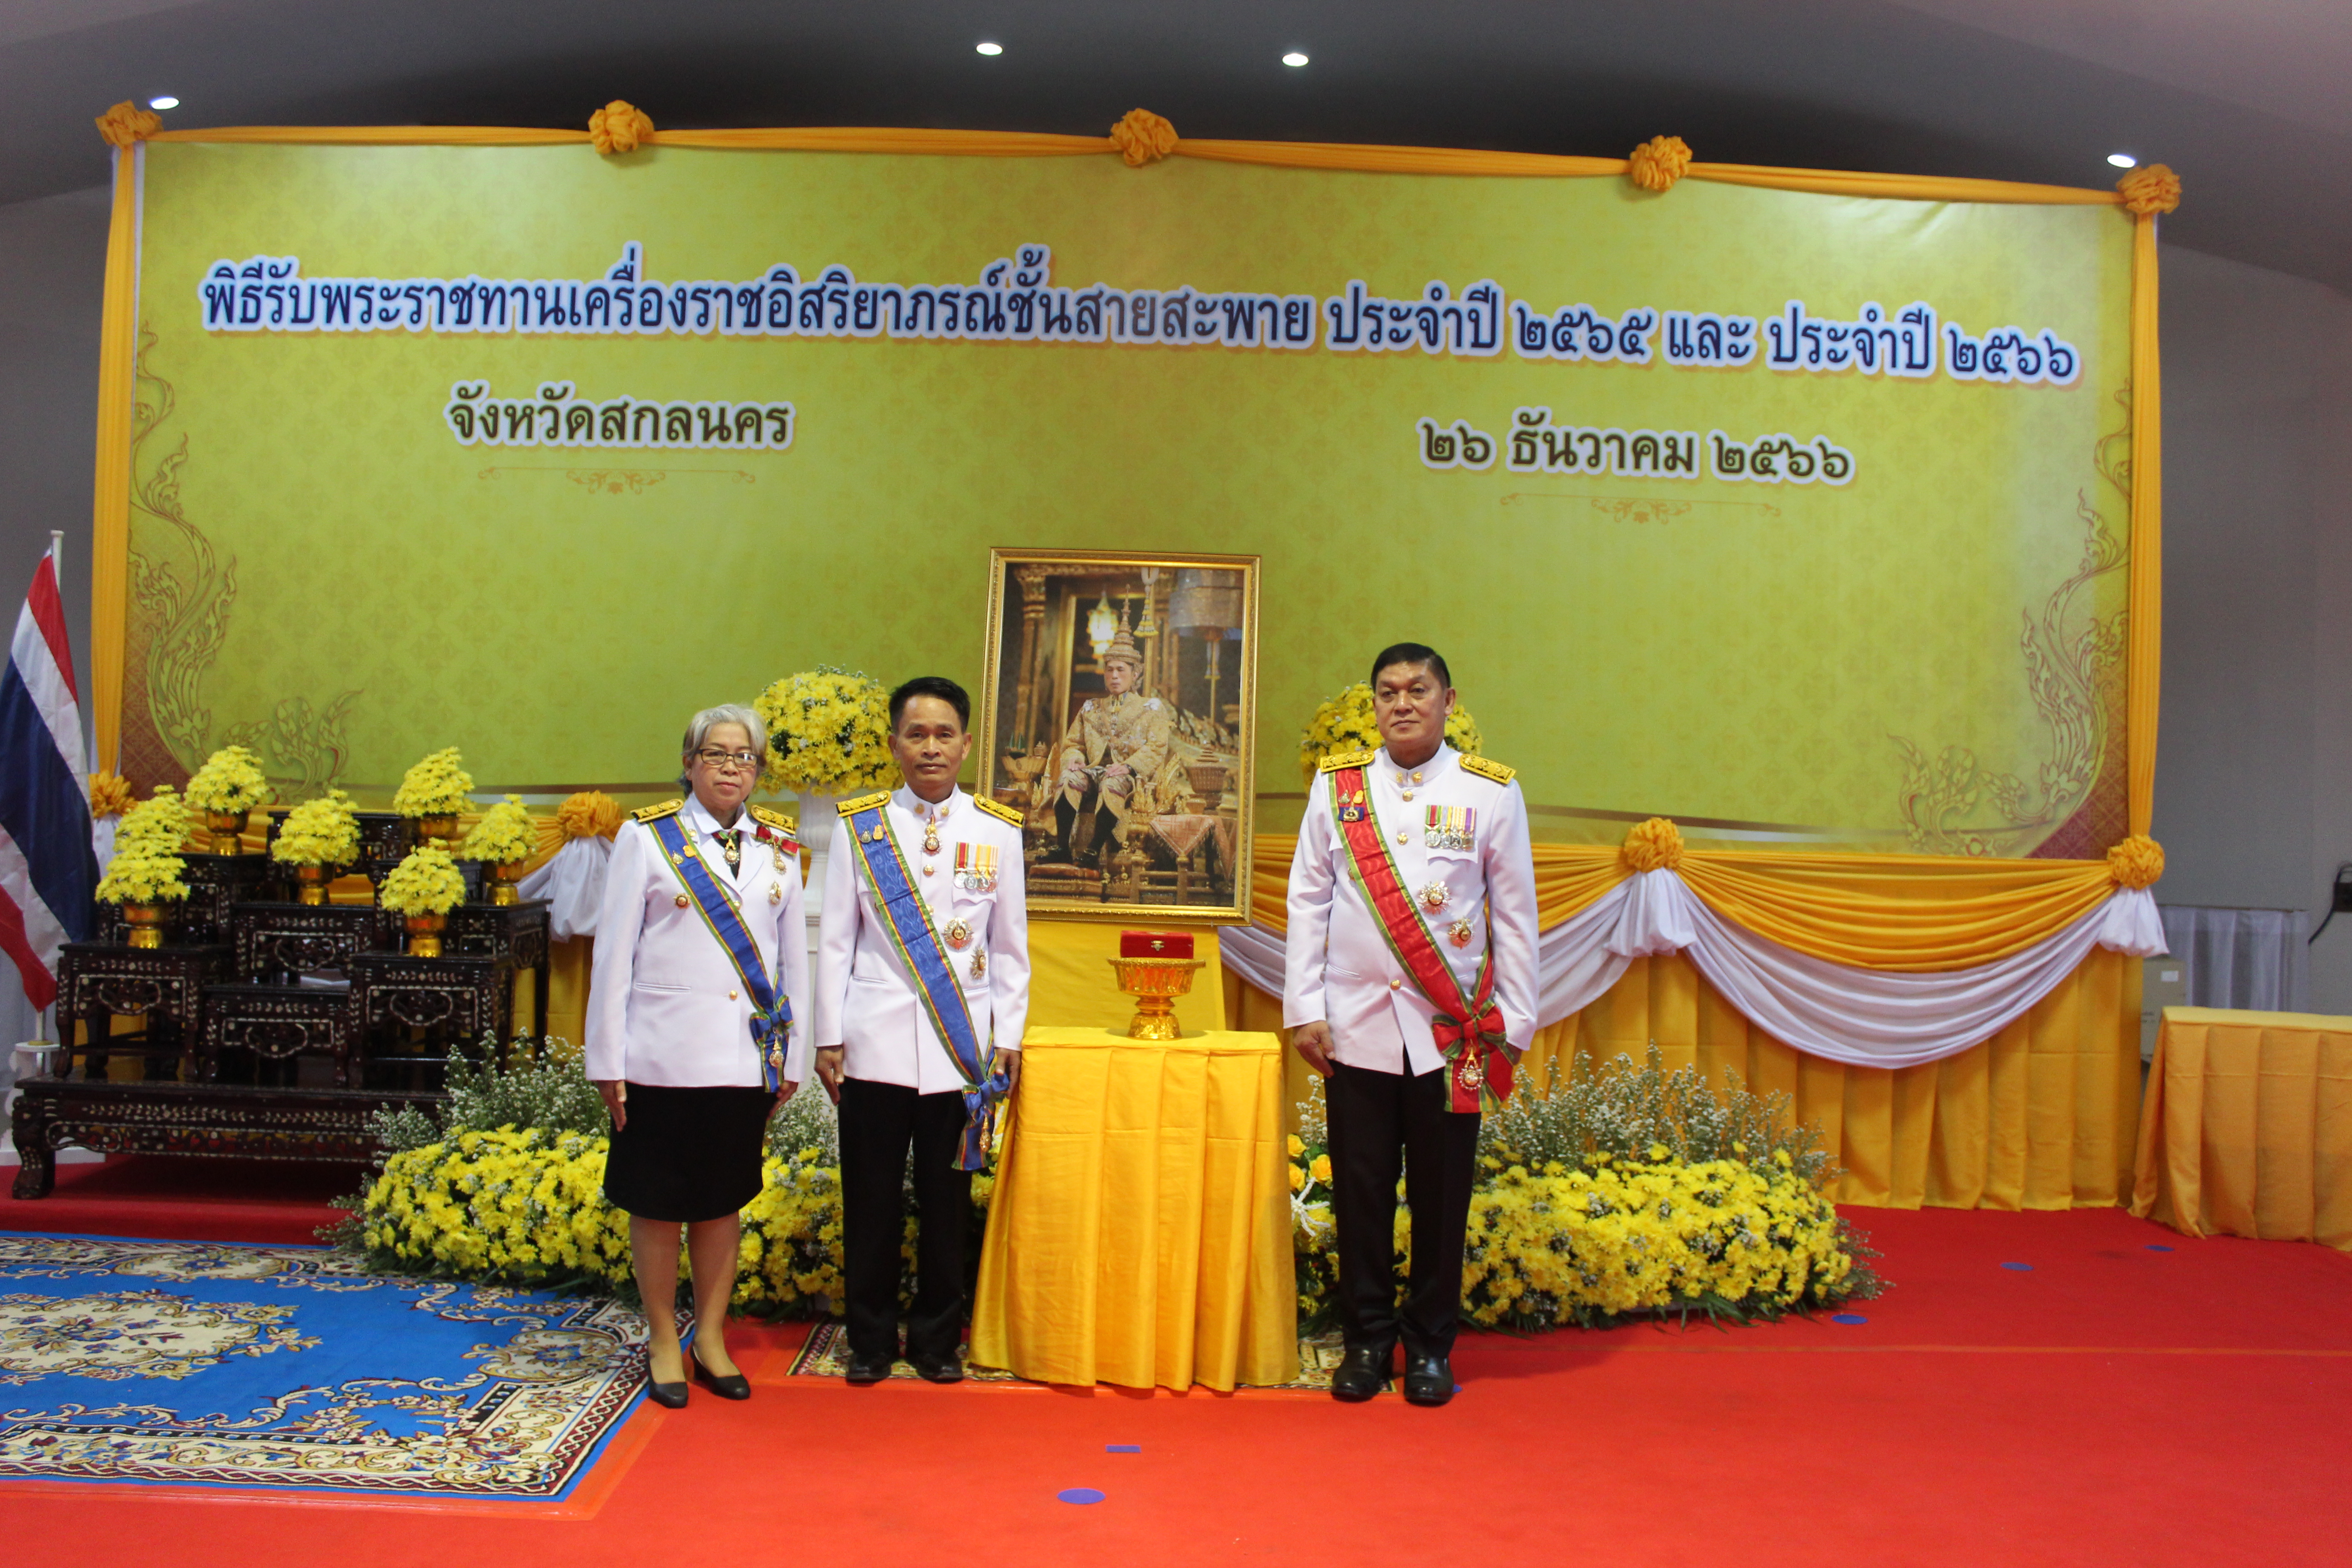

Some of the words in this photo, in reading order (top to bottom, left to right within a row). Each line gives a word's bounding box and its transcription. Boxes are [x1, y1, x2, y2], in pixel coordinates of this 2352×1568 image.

[204, 247, 1310, 342] พิธีรับพระราชทานเครื่องราชอิสริยาภรณ์ชั้นสายสะพาย
[1329, 285, 1499, 350] ประจำปี
[1516, 306, 1653, 356] ๒๕๖๕
[1668, 316, 1752, 360] และ
[1769, 306, 1931, 371] ประจำปี
[1948, 328, 2075, 378] ๒๕๖๖
[449, 385, 789, 444] จังหวัดสกลนคร
[1421, 421, 1491, 464] ๒๖
[1511, 411, 1695, 472] ธันวาคม
[1712, 435, 1850, 479] ๒๕๖๖
